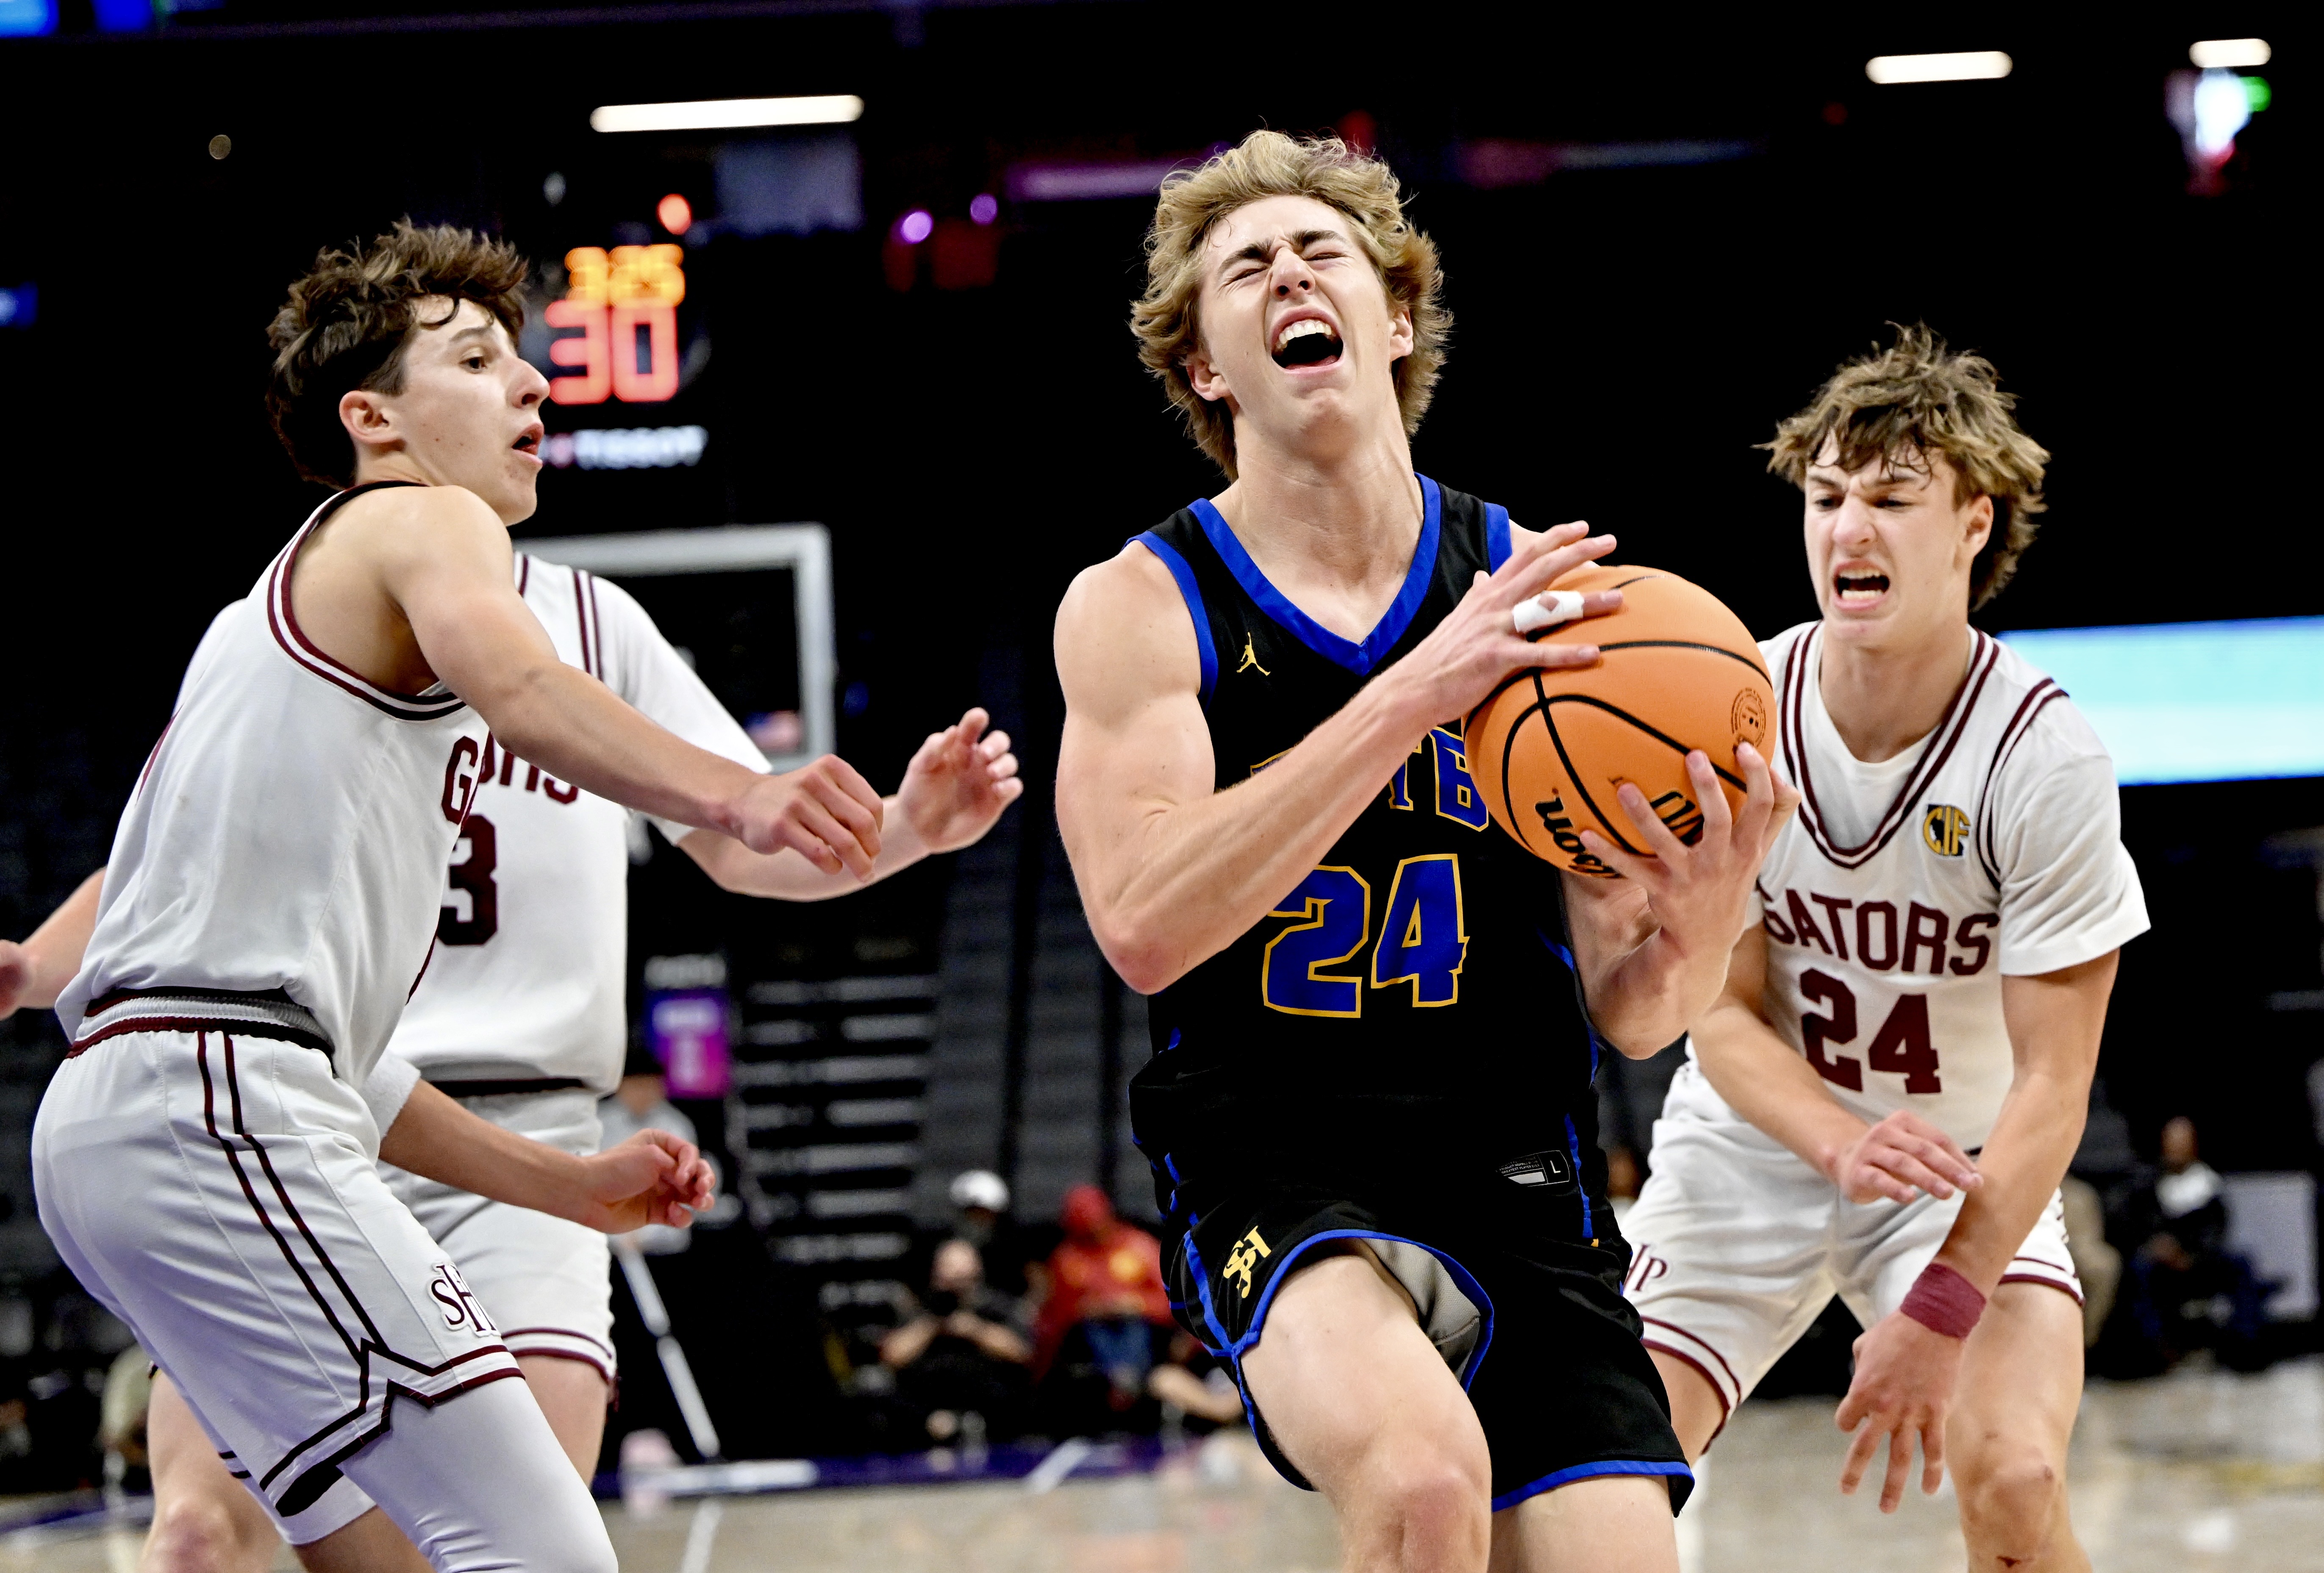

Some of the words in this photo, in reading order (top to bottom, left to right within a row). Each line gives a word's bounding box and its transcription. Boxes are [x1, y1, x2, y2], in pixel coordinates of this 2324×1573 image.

[545, 299, 678, 404] 30
[1923, 804, 1971, 856] CIF
[1262, 854, 1470, 1018] 24
[1800, 967, 1942, 1095] 24
[1550, 1160, 1561, 1173] L
